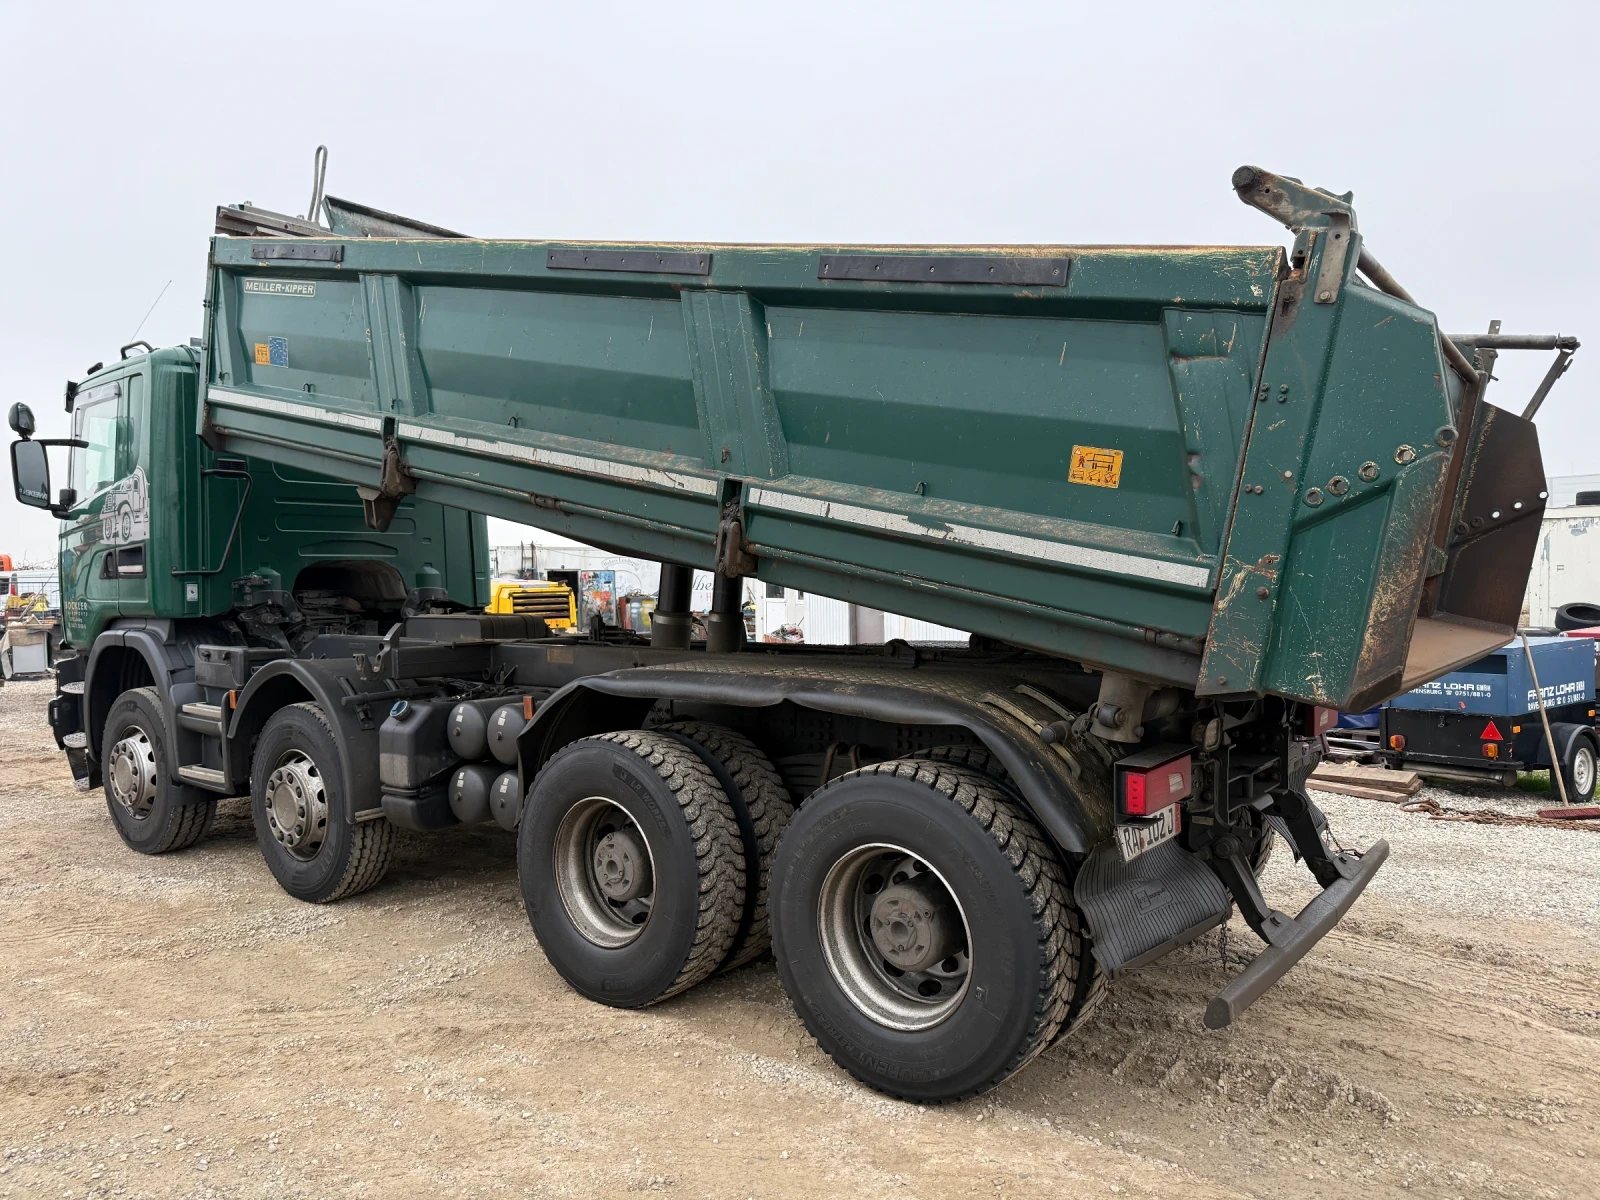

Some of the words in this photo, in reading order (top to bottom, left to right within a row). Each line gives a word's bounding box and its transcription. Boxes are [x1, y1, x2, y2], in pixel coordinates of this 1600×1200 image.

[245, 281, 314, 294] MEILLER-KIPPER
[1443, 682, 1475, 691] LOHR
[1555, 682, 1575, 696] LOHR
[1454, 690, 1491, 698] 0751/881-0
